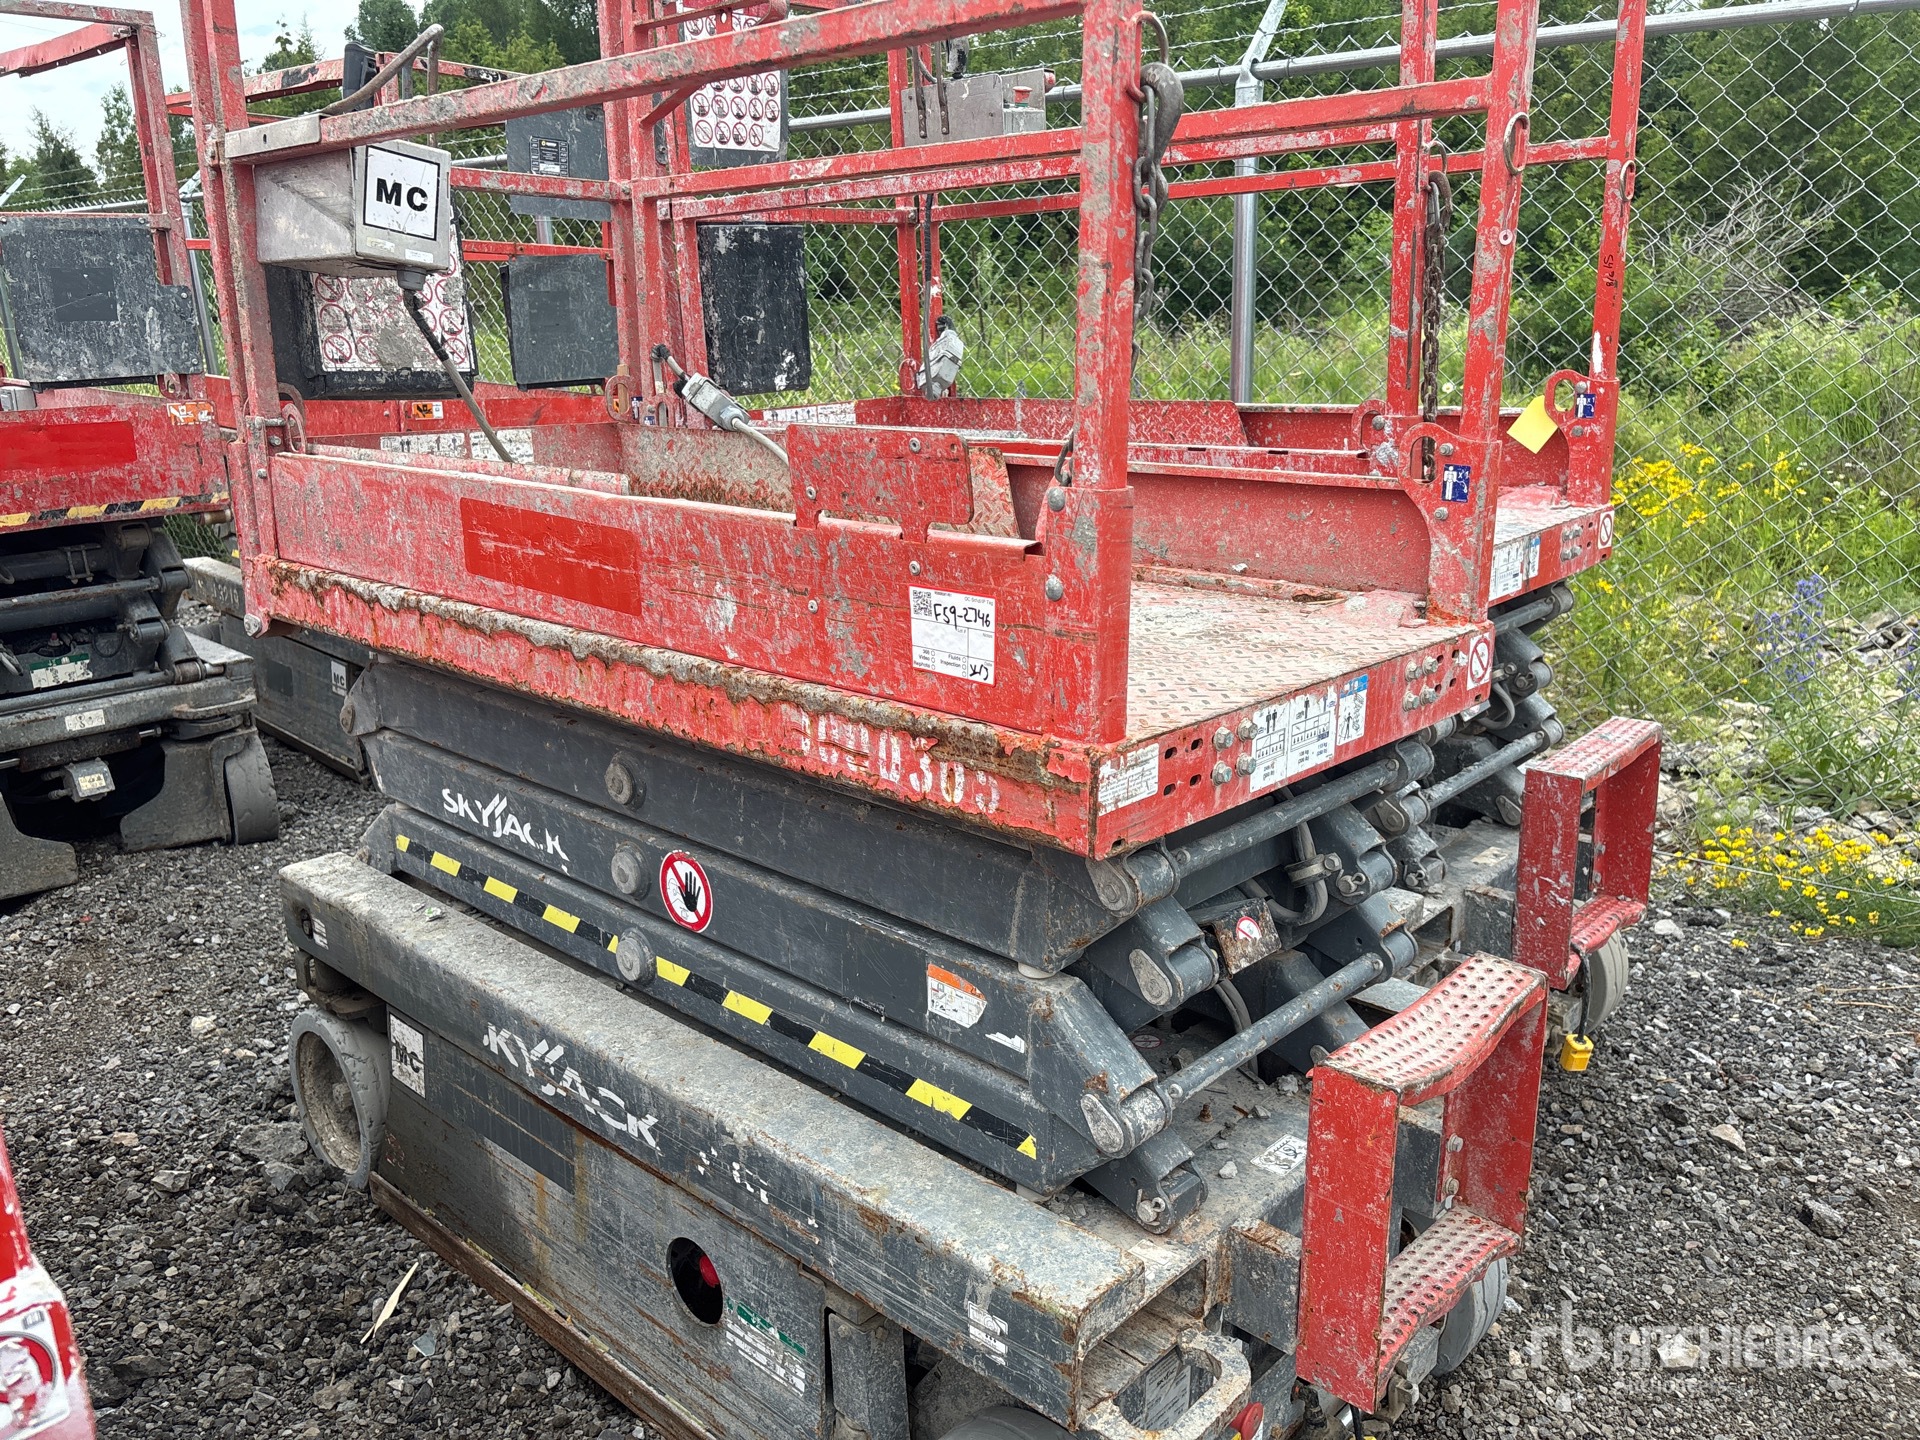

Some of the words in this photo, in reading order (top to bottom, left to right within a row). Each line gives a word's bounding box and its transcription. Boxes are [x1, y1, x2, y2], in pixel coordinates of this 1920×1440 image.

[375, 176, 429, 212] MC
[333, 671, 345, 687] MC
[940, 660, 961, 668] Inspection
[441, 787, 571, 862] SKYJACK
[483, 1021, 663, 1157] KYJACK
